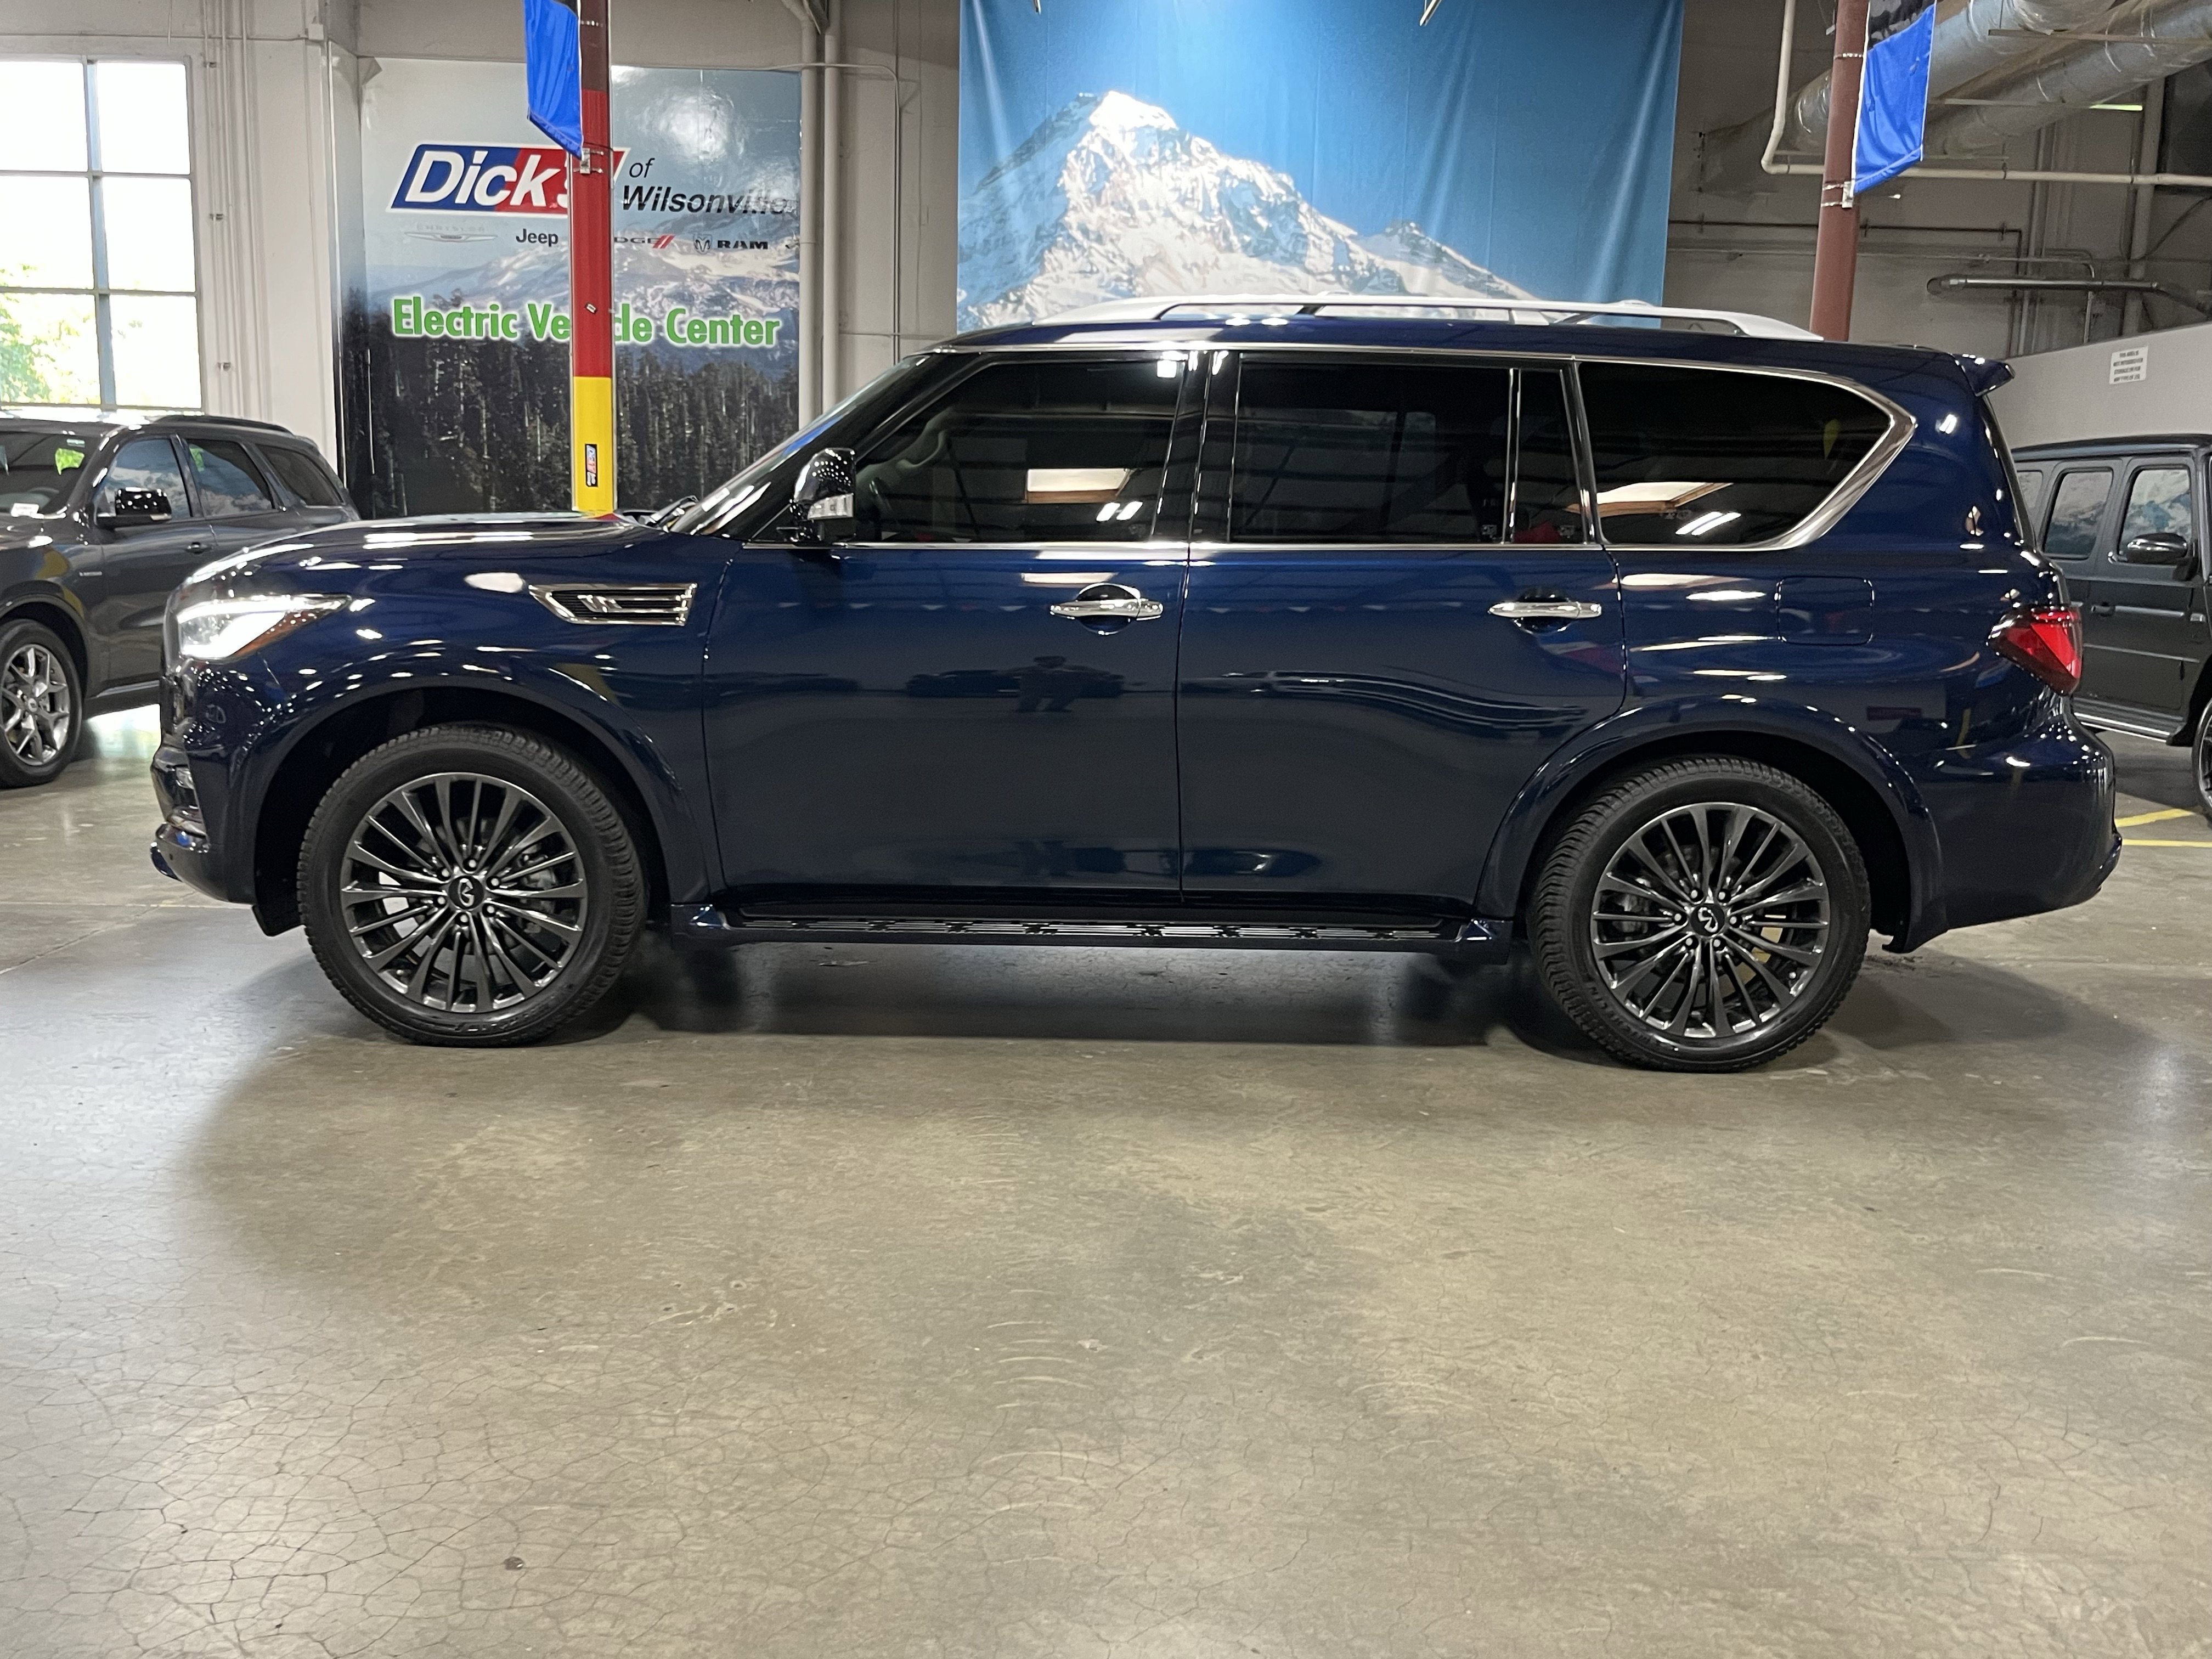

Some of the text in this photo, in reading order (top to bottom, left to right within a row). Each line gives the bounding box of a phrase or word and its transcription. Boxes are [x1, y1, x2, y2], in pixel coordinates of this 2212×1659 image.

[405, 150, 655, 208] Dick of
[516, 228, 558, 247] Jeep
[718, 240, 768, 250] RAM
[394, 296, 780, 345] Electric Vele Center
